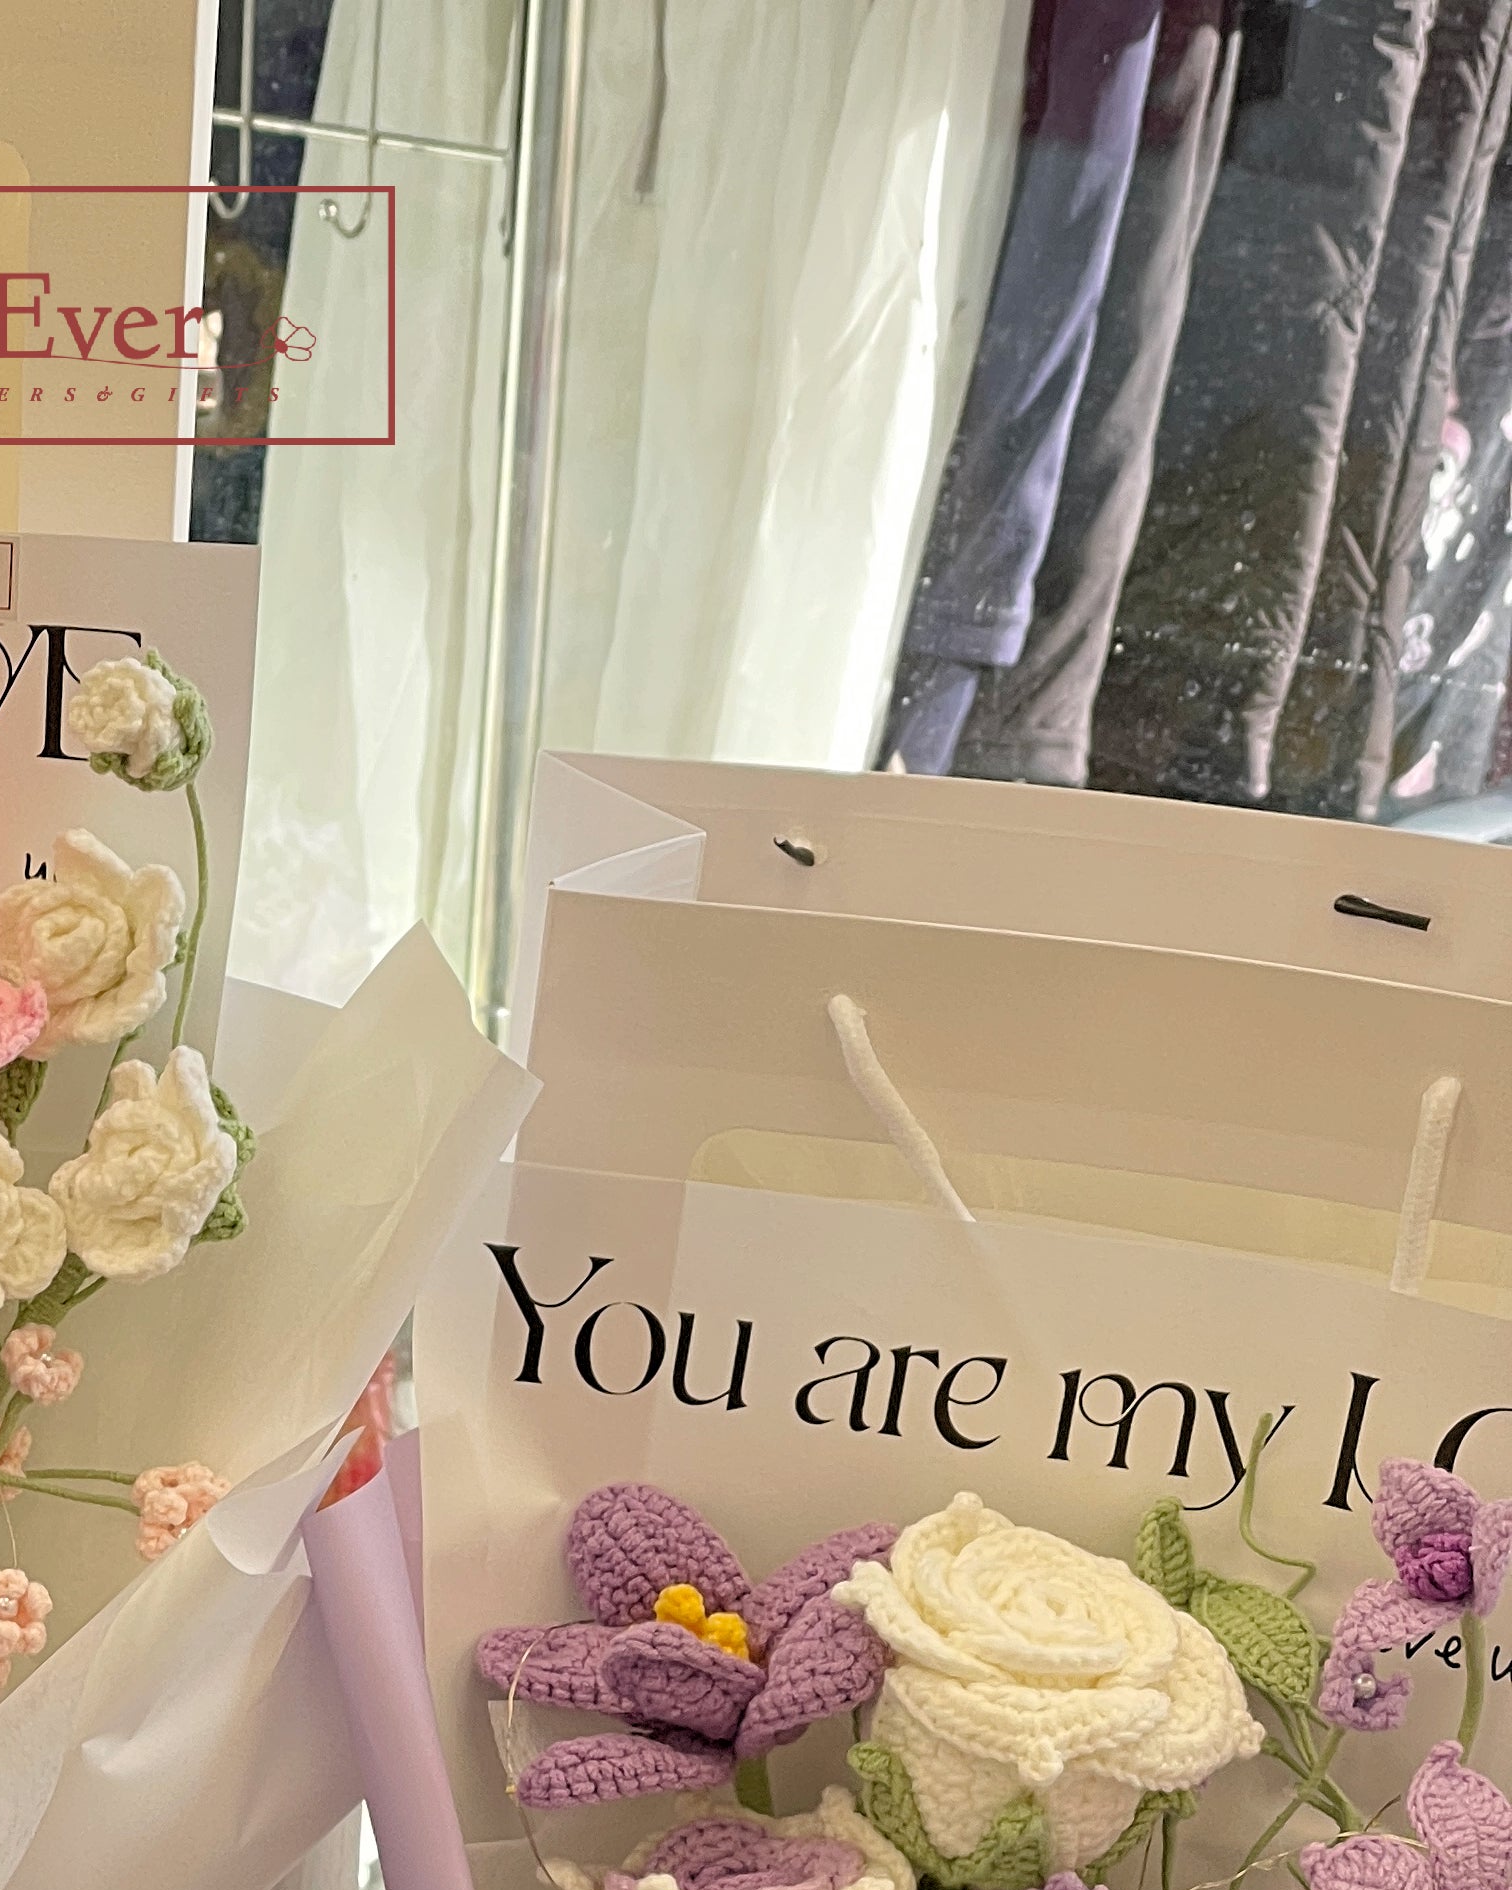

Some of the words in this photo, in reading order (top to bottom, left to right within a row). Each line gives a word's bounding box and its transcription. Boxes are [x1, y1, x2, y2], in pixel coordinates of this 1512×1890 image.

[484, 1243, 754, 1411] You
[794, 1336, 1008, 1450] are
[1046, 1368, 1296, 1511] my
